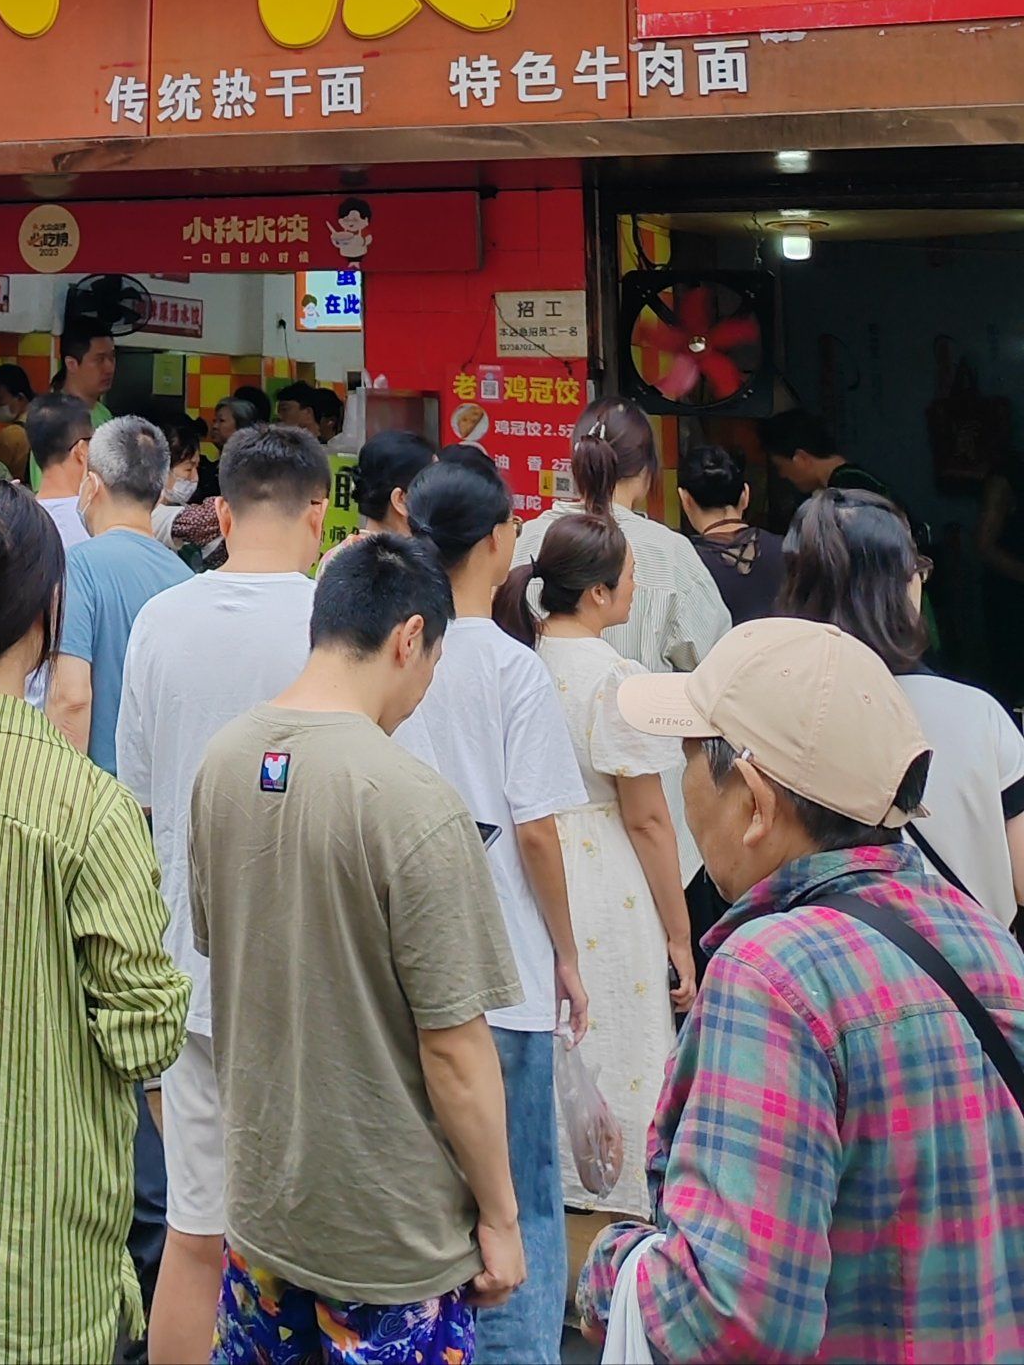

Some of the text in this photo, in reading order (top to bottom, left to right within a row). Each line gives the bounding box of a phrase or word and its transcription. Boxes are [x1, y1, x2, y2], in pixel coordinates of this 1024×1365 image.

[449, 39, 750, 109] 特色牛肉面
[105, 66, 365, 124] 传统热干面
[182, 214, 309, 245] 小秋水饺
[39, 248, 59, 257] 2023
[517, 301, 562, 318] 招工
[453, 373, 580, 405] 老鸡冠饺
[649, 717, 693, 727] ARTENGO
